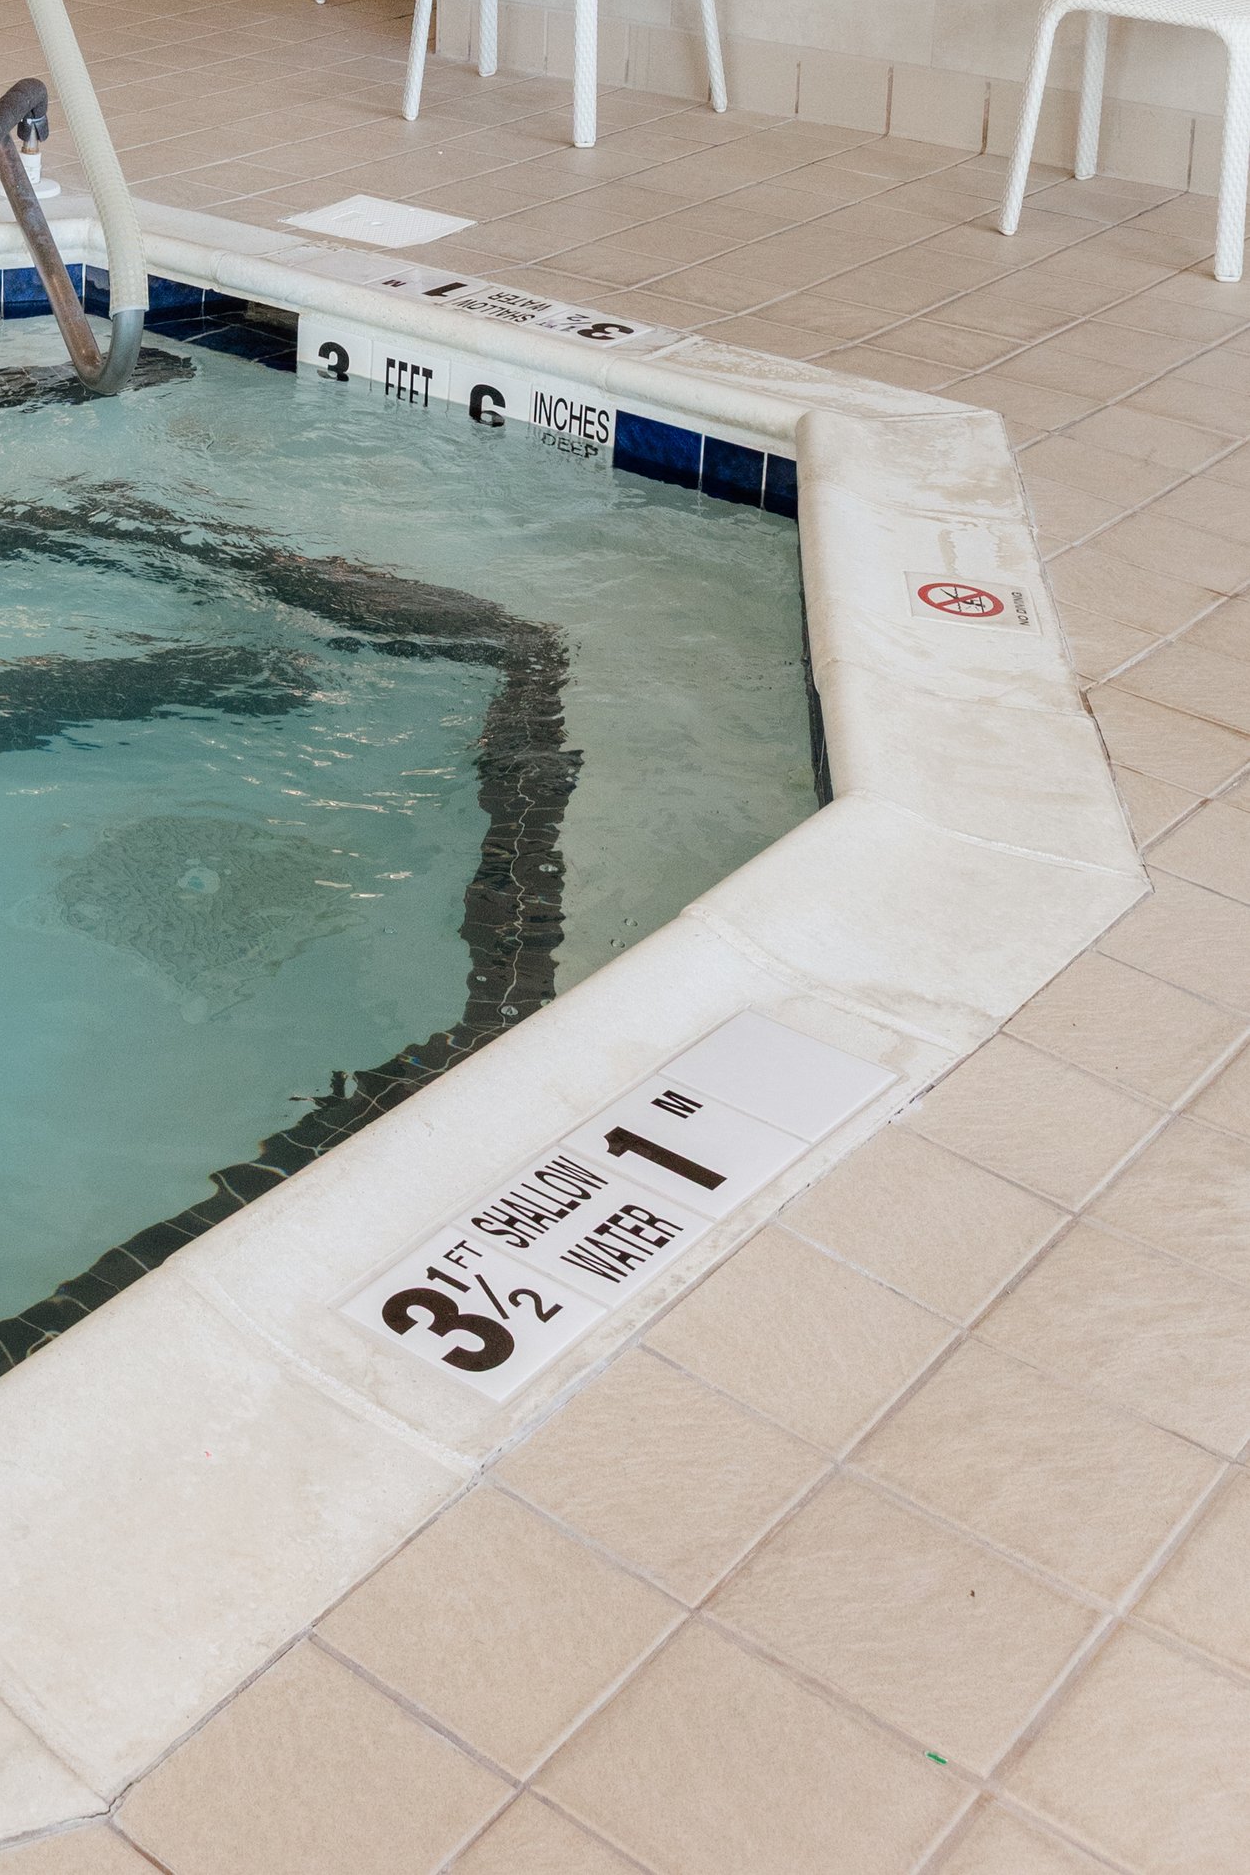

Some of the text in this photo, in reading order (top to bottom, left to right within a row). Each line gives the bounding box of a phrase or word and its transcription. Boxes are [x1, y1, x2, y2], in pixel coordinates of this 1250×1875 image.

[454, 298, 536, 323] SHALLOW
[487, 291, 552, 313] WATER
[317, 341, 350, 382] 3
[385, 357, 433, 407] FEET
[534, 391, 609, 444] INCHES
[1011, 591, 1031, 627] NO DIVING
[603, 1089, 728, 1191] 1 M
[470, 1155, 609, 1249] SHALLOW
[442, 1239, 483, 1270] FT
[559, 1203, 684, 1284] WATER
